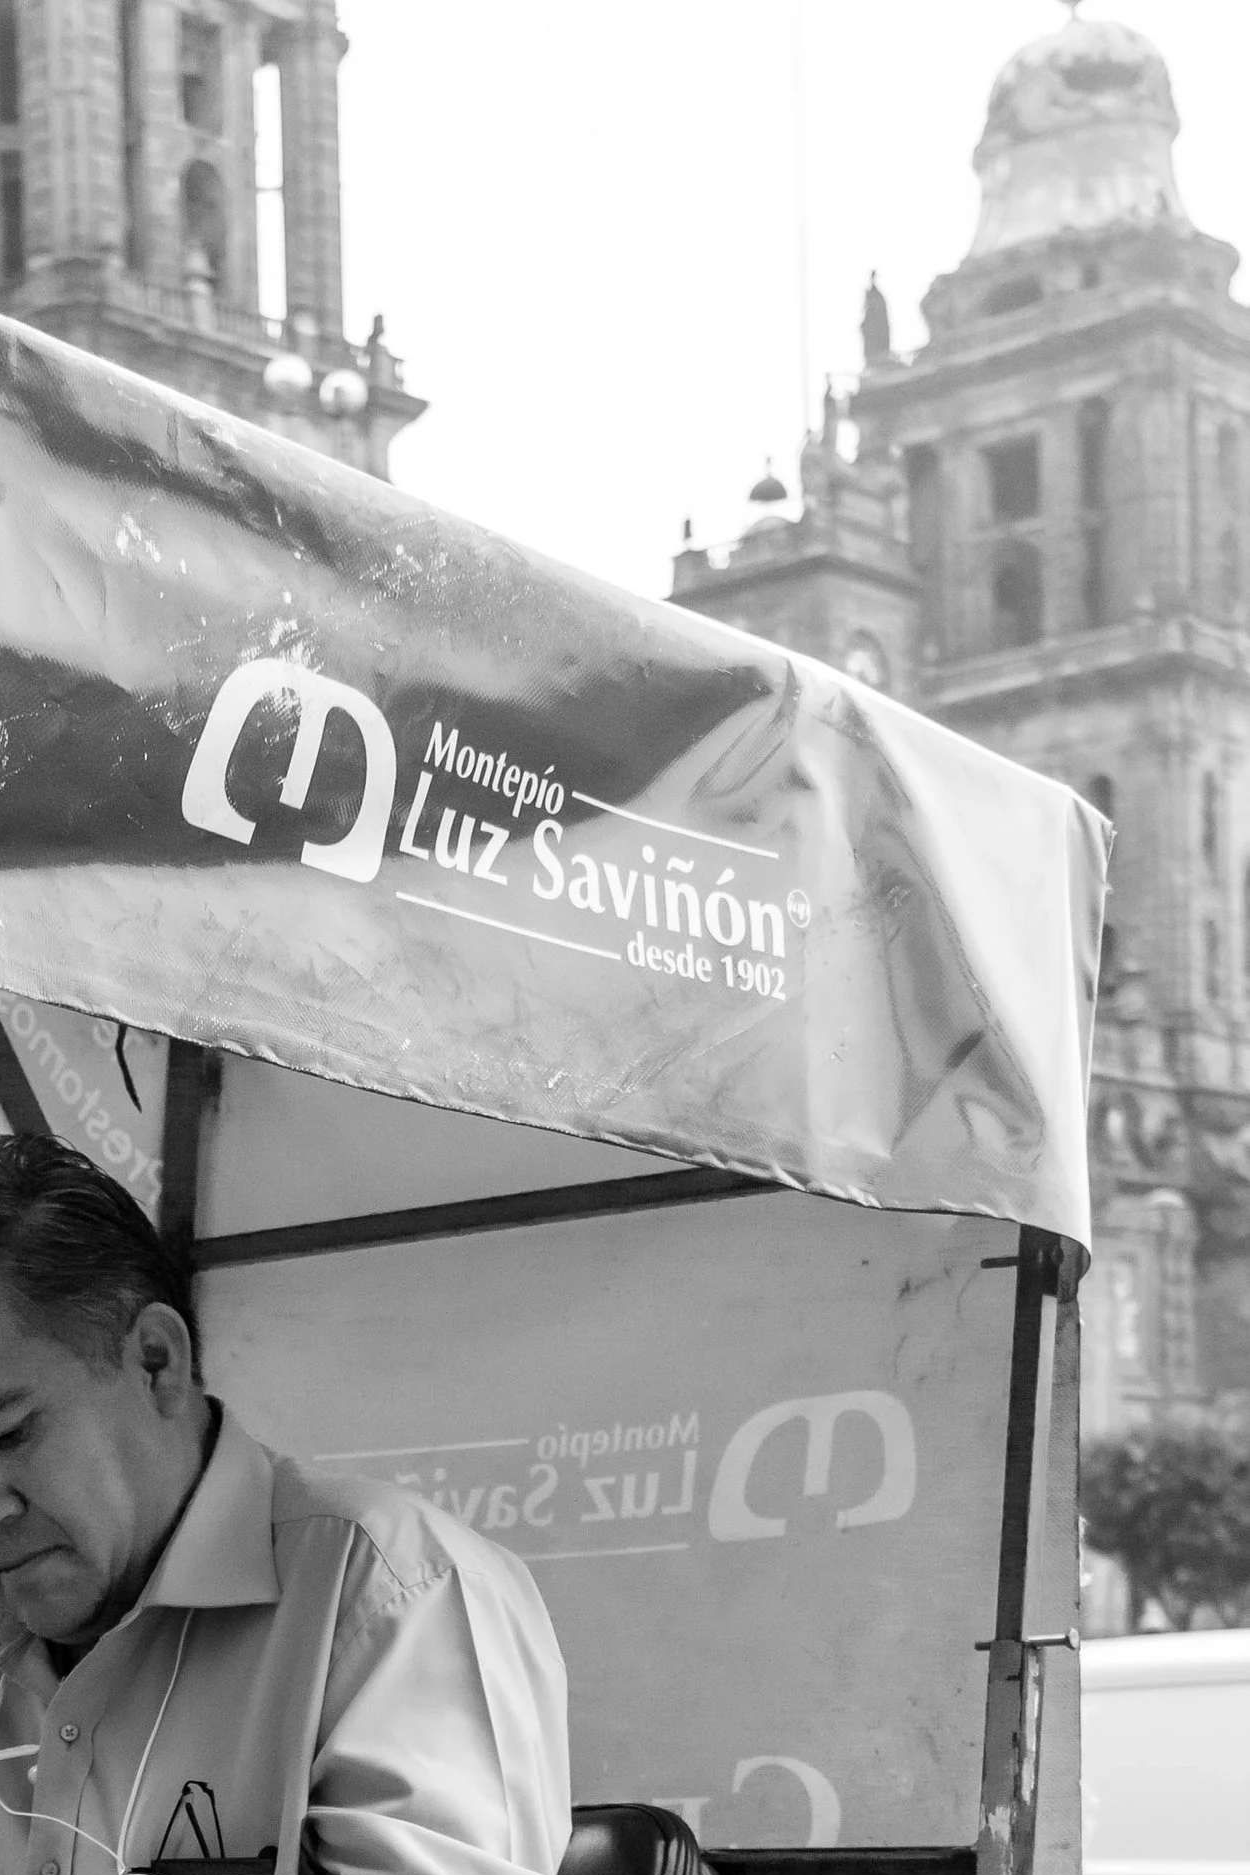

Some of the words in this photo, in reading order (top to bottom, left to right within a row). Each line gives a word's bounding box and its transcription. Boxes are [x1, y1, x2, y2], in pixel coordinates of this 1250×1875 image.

[423, 721, 565, 818] Montepío
[398, 770, 509, 886] Luz
[531, 817, 786, 958] Saviñón
[626, 930, 712, 983] desde
[720, 953, 786, 1001] 1902
